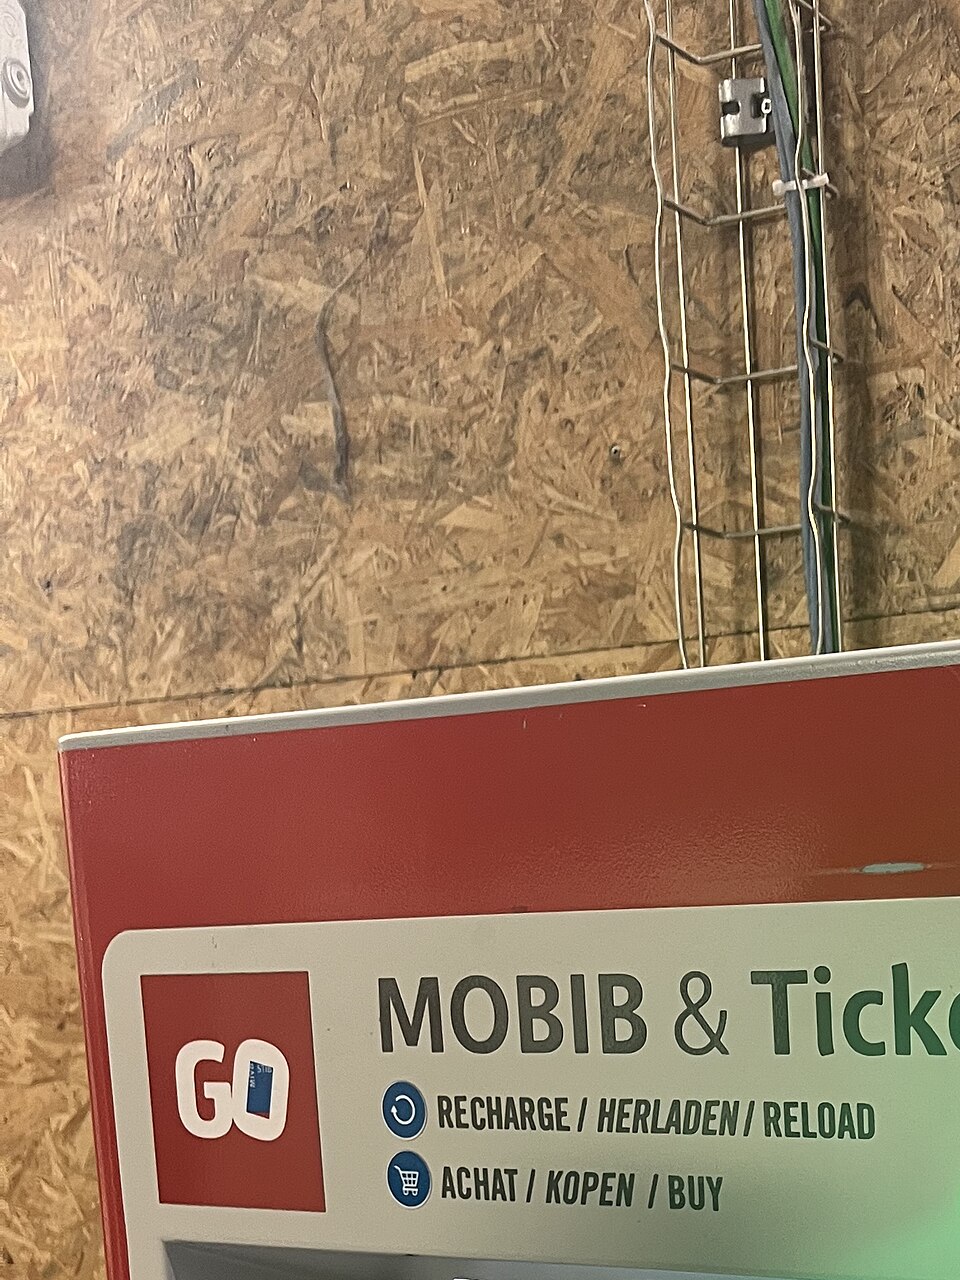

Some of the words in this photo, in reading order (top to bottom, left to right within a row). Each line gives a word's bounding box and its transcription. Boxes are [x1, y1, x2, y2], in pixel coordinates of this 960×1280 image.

[378, 973, 648, 1055] MOBIB
[674, 970, 730, 1056] &
[175, 1038, 290, 1142] GO
[437, 1095, 571, 1133] RECHARGE
[576, 1097, 588, 1133] /
[597, 1097, 740, 1136] HERLADEN
[743, 1100, 755, 1137] /
[763, 1100, 876, 1140] RELOAD
[441, 1166, 518, 1203] ACHAT
[526, 1169, 536, 1203] /
[545, 1170, 635, 1207] KOPEN
[648, 1173, 660, 1209] /
[668, 1174, 724, 1211] BUY
